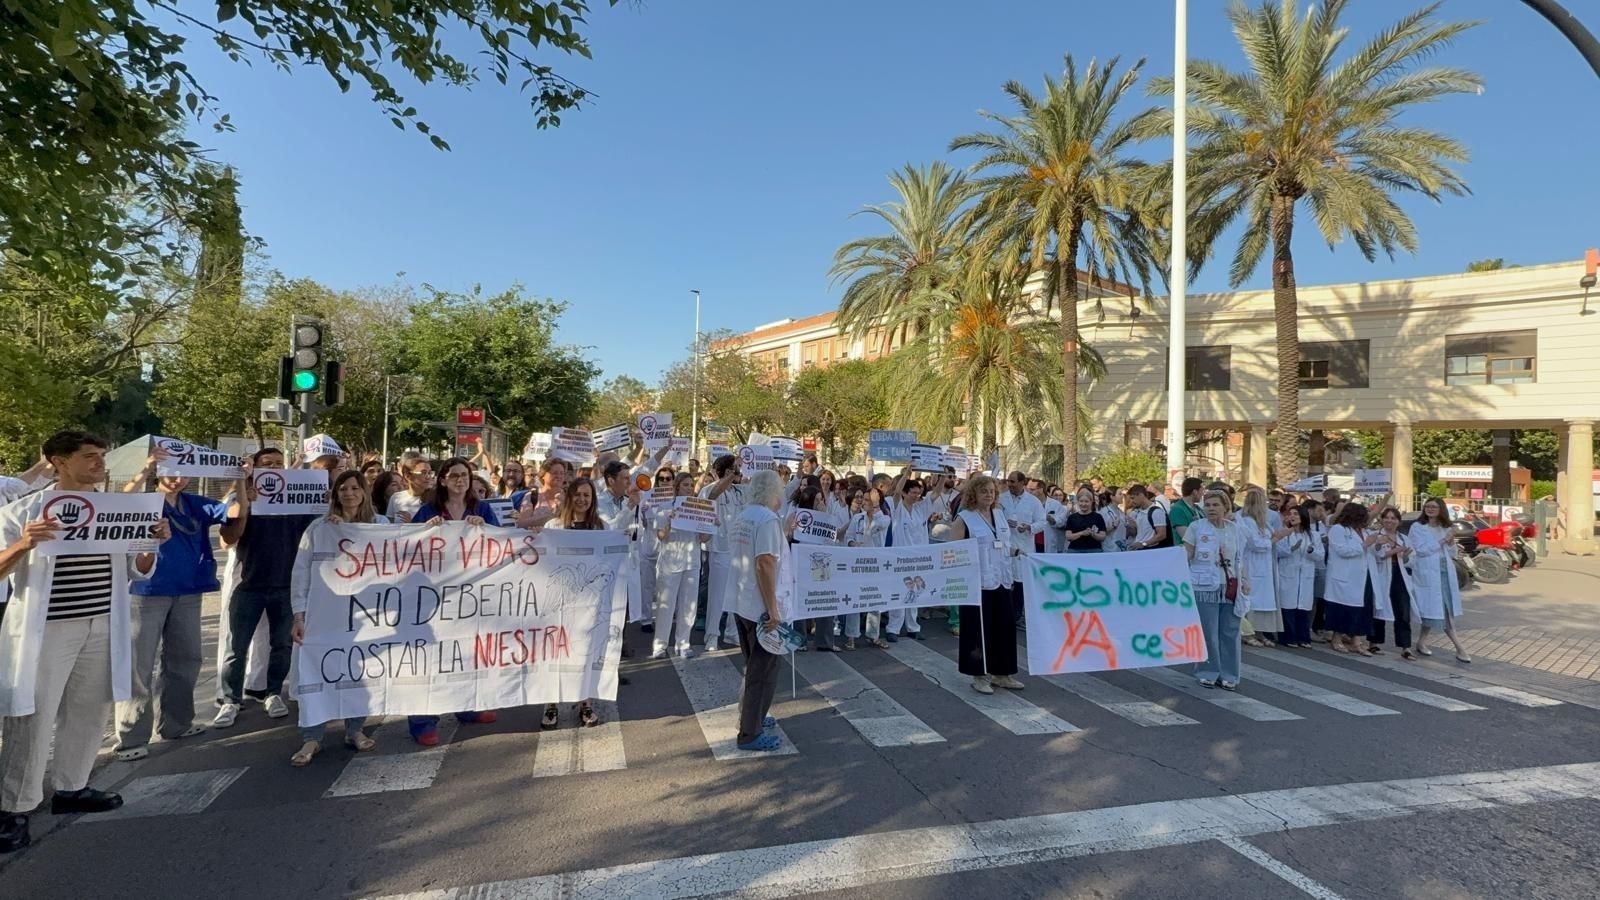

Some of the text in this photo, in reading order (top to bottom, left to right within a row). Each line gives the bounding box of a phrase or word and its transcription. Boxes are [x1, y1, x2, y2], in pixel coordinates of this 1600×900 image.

[177, 453, 196, 466] 24
[286, 483, 328, 491] GUARDIAS
[268, 493, 284, 504] 24
[96, 511, 160, 523] GUARDIAS
[63, 525, 90, 541] 24
[801, 526, 836, 540] 24 HORAS
[334, 534, 540, 579] SALVAR VIDAS
[896, 555, 933, 564] Productividad
[851, 566, 880, 574] SATURADA
[893, 565, 916, 573] variable
[1039, 565, 1194, 610] 35 horas
[346, 578, 538, 632] NO DEBERÍA
[1053, 610, 1118, 672] YA
[320, 624, 571, 684] COSTAR LA NUESTRA
